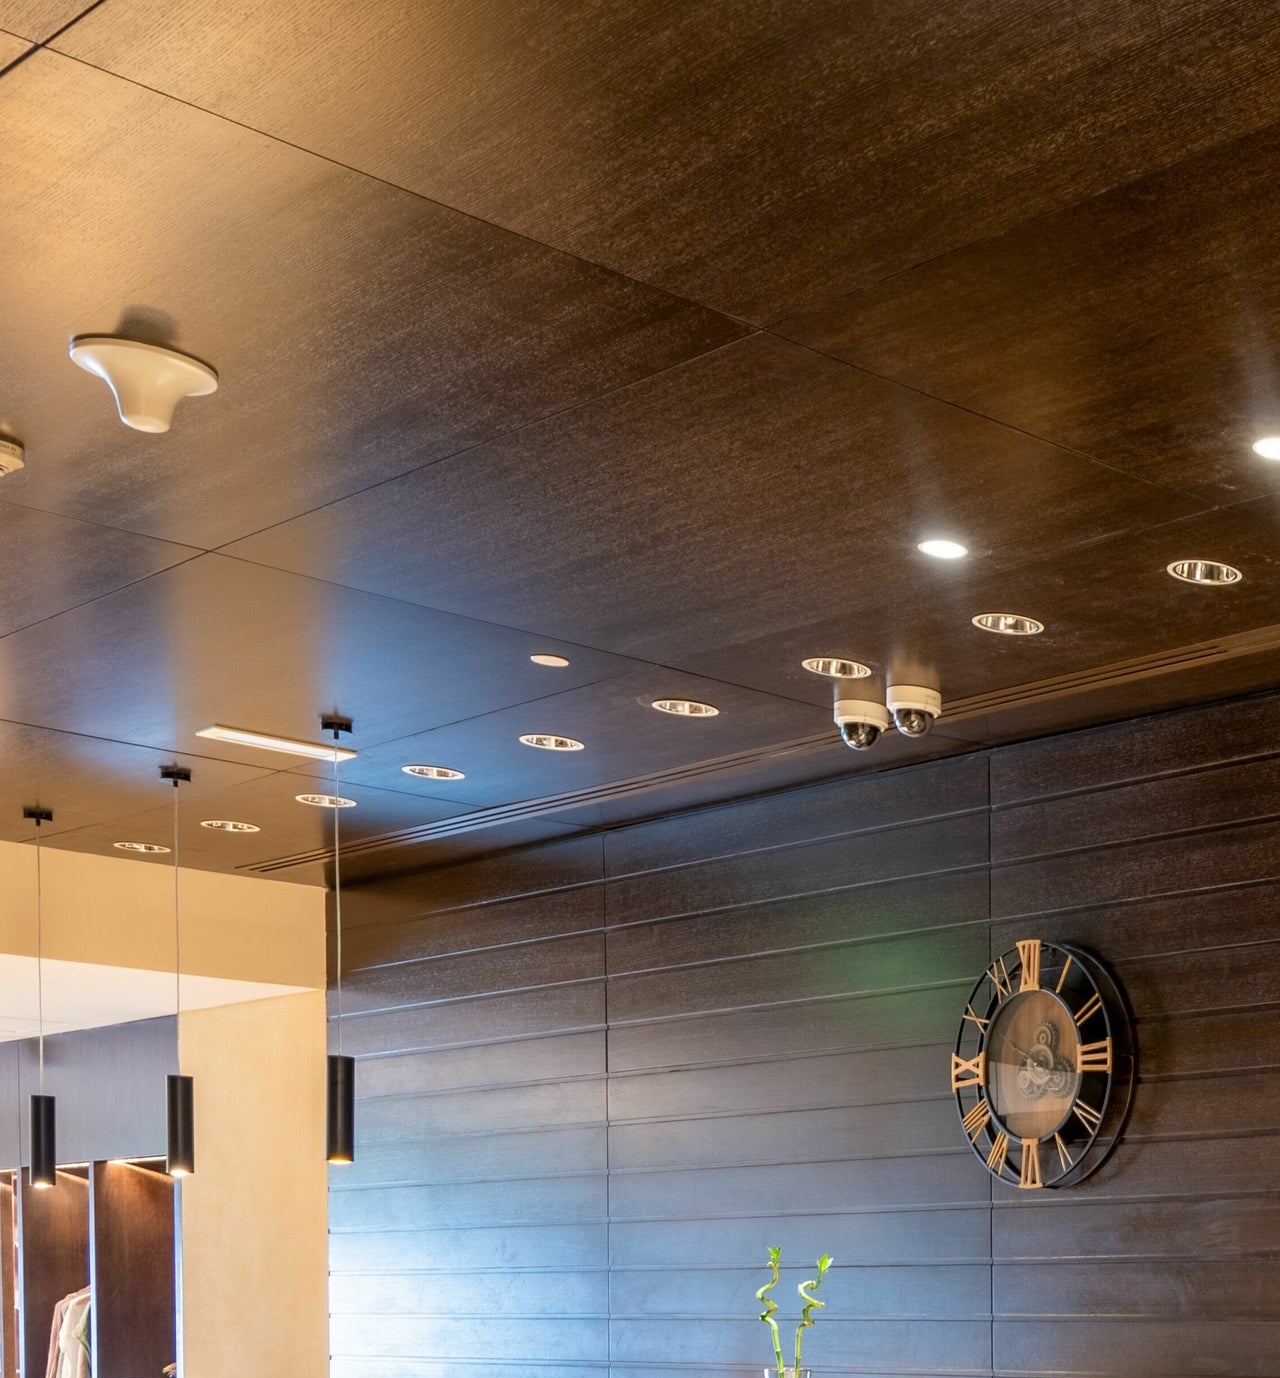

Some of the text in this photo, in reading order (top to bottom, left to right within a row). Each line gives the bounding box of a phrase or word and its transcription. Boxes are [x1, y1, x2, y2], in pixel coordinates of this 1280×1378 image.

[986, 955, 1012, 1005] XI
[1016, 939, 1041, 993] XII
[962, 1003, 991, 1036] X
[951, 1051, 985, 1093] IX
[1076, 1036, 1112, 1074] III
[1018, 1137, 1043, 1189] VI
